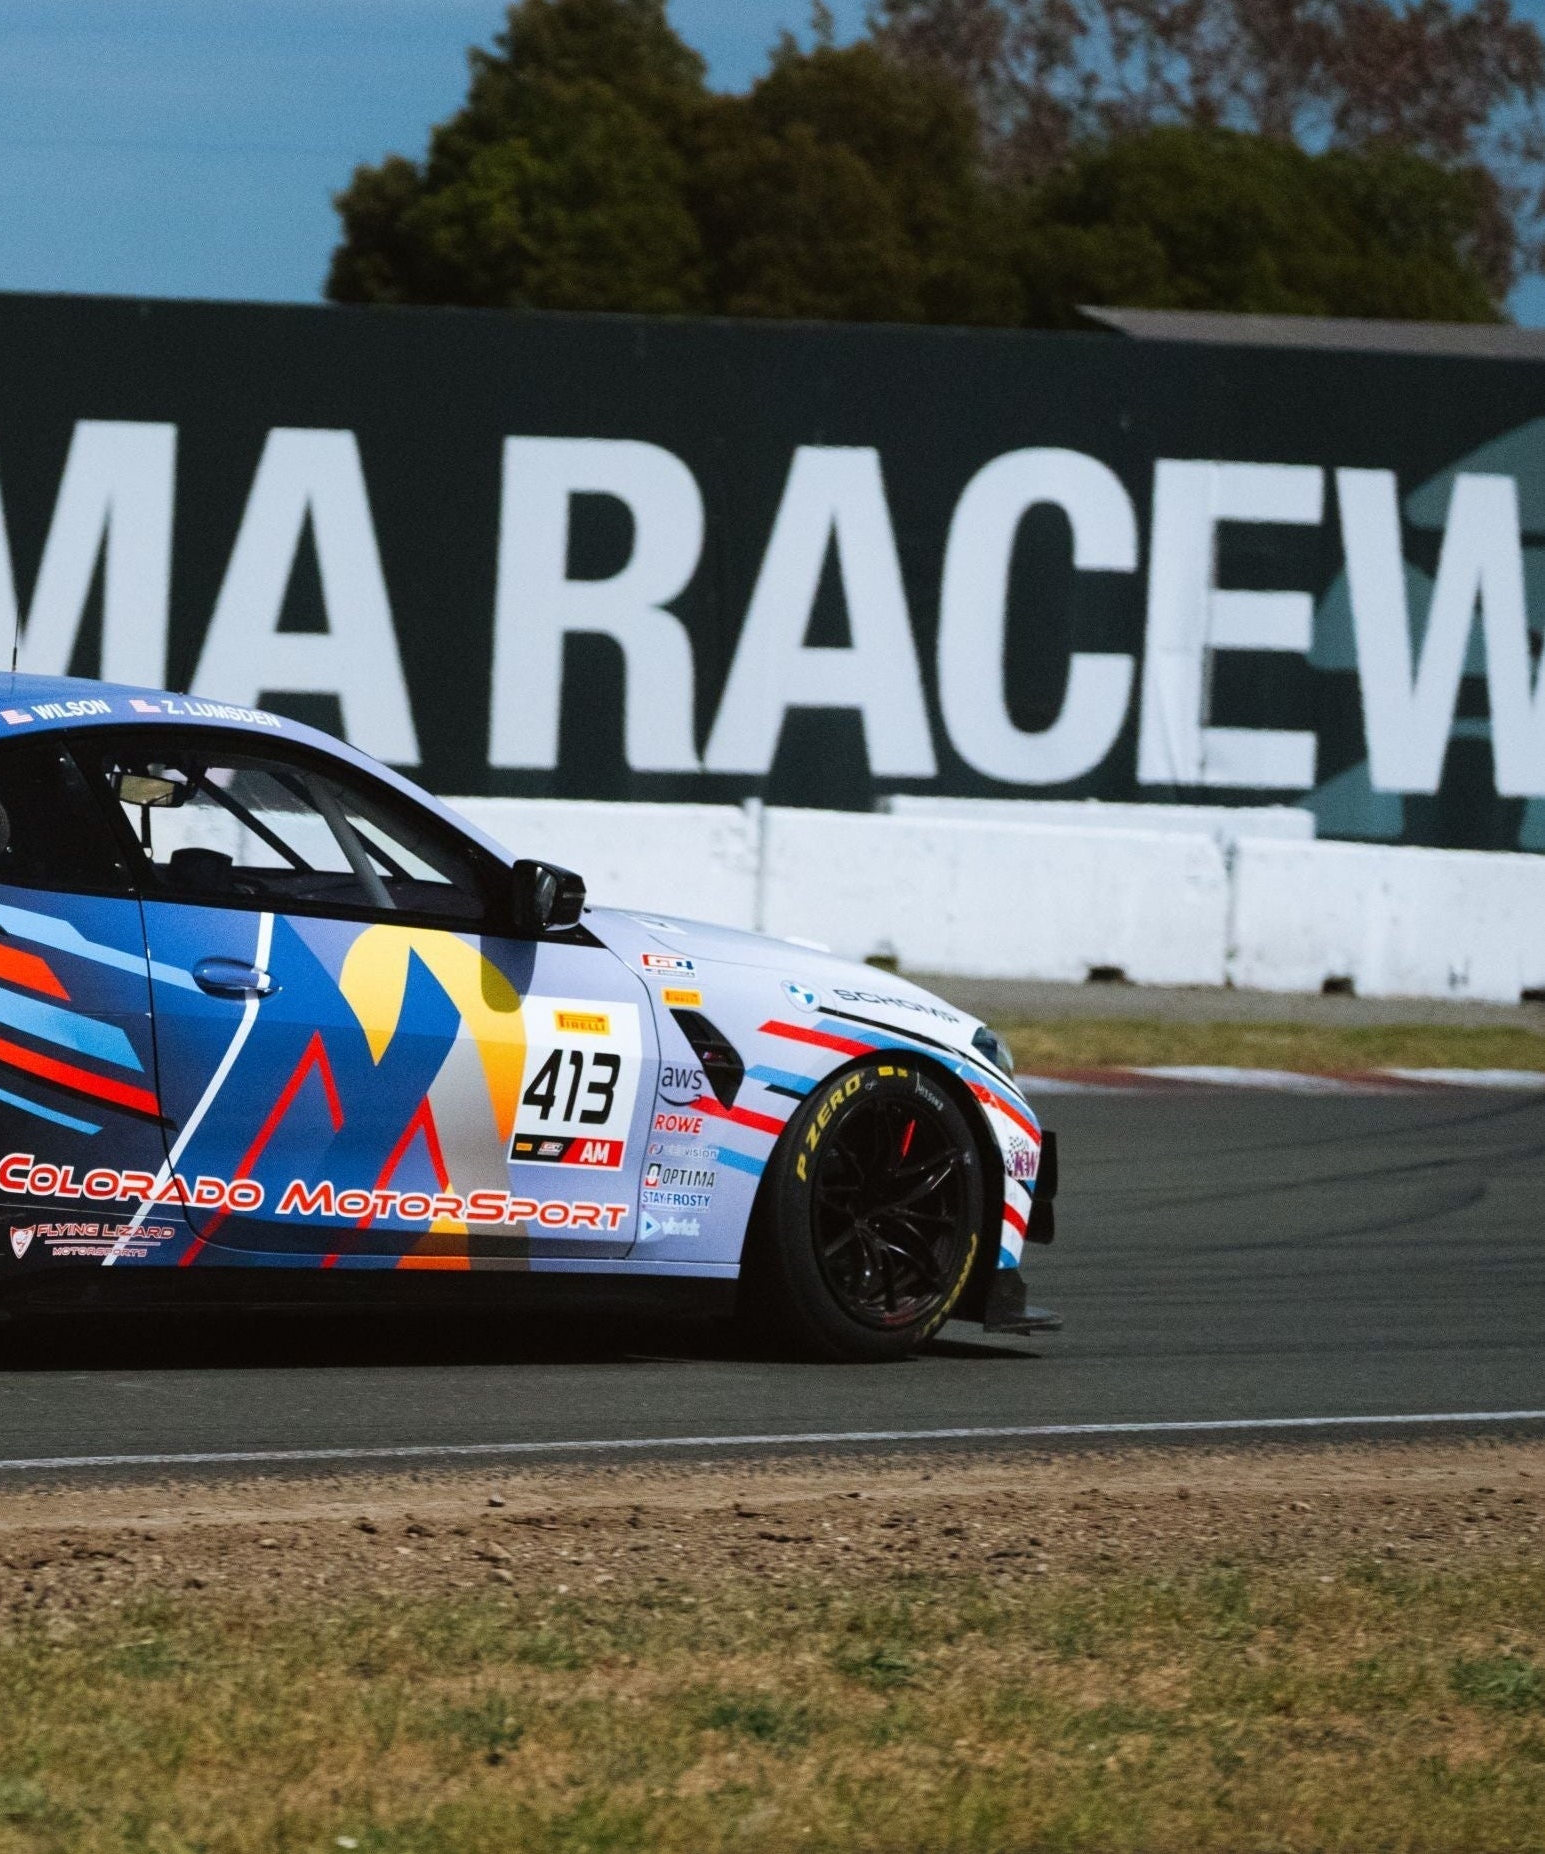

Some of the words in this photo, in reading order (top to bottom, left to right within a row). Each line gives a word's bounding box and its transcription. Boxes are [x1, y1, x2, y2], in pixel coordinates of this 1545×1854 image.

[488, 435, 1545, 796] RACEW
[31, 699, 112, 720] WILSON
[163, 700, 185, 715] Z.
[191, 702, 283, 728] LUMSDEN
[557, 1013, 607, 1032] PIRELLI
[522, 1048, 621, 1125] 413
[661, 1066, 704, 1090] aws
[654, 1113, 703, 1134] ROWE
[796, 1152, 807, 1182] P
[806, 1073, 862, 1152] ZERO
[579, 1141, 611, 1164] AM
[662, 1168, 715, 1188] OPTIMA
[274, 1179, 630, 1230] MOTORSPORT
[642, 1191, 665, 1204] STAY
[666, 1193, 711, 1207] FROSTY
[36, 1223, 99, 1237] FLYING
[102, 1224, 176, 1240] LIZARD
[52, 1246, 148, 1258] MOTORSPORTS
